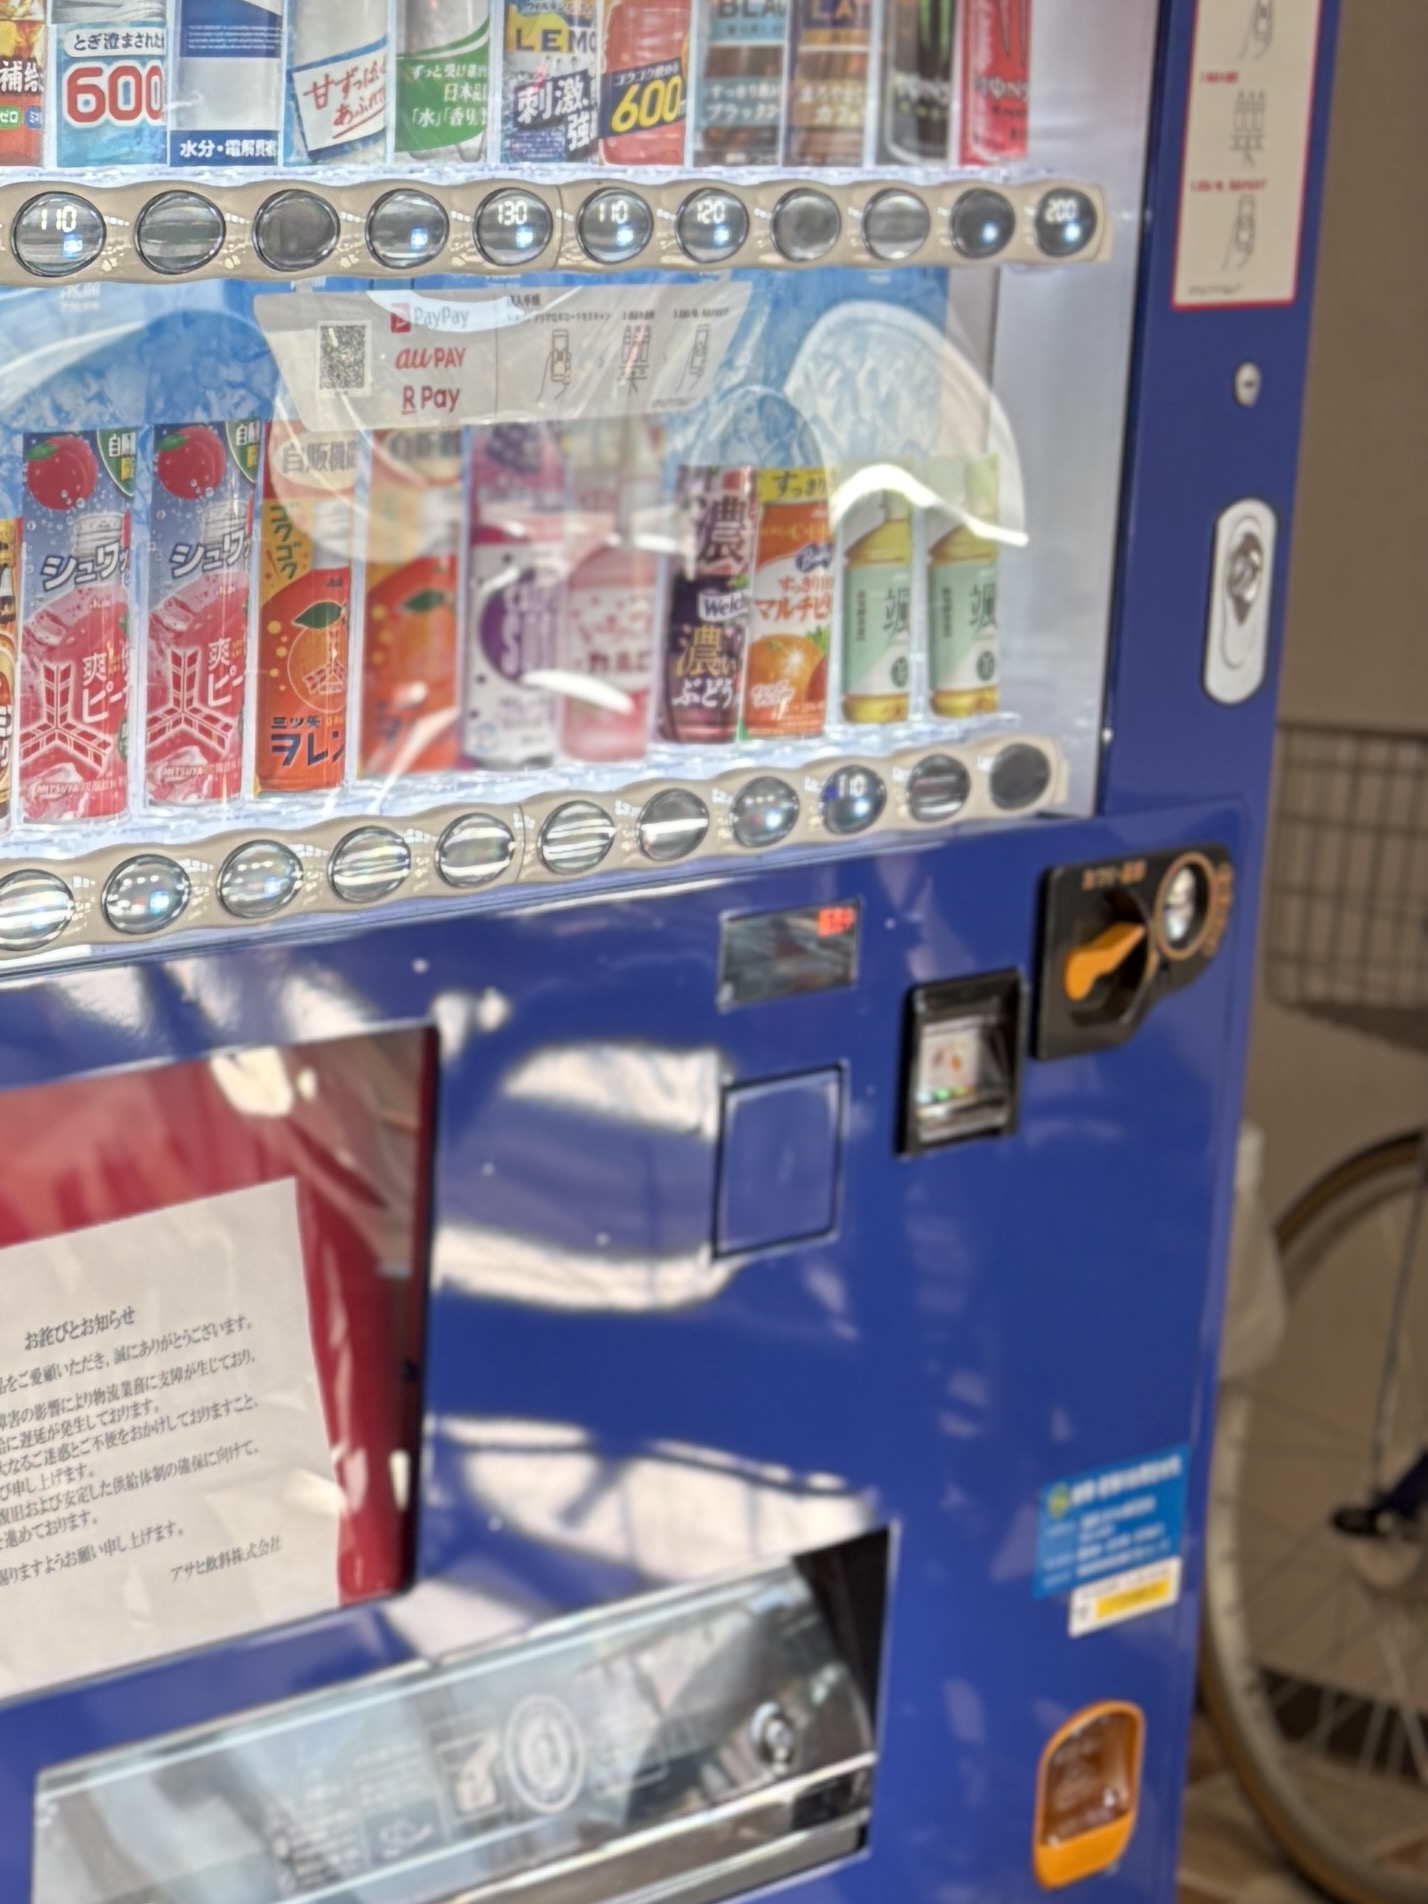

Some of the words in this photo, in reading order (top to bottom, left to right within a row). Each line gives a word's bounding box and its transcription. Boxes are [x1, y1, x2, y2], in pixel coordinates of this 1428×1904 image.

[66, 64, 163, 124] 600
[611, 76, 682, 133] 600
[41, 205, 77, 232] 110
[497, 202, 527, 225] 130
[599, 202, 628, 224] 110
[696, 202, 725, 223] 120
[1047, 201, 1077, 221] 200
[413, 306, 469, 329] PayPay
[395, 348, 433, 370] au
[434, 347, 466, 369] PAY
[421, 385, 460, 412] Pay
[170, 527, 250, 580] シュワ
[208, 665, 243, 708] ピー
[82, 680, 127, 724] ピー
[24, 1306, 136, 1352] お詫びとお知らせ
[170, 1535, 282, 1583] アサヒ飲料株式会社
